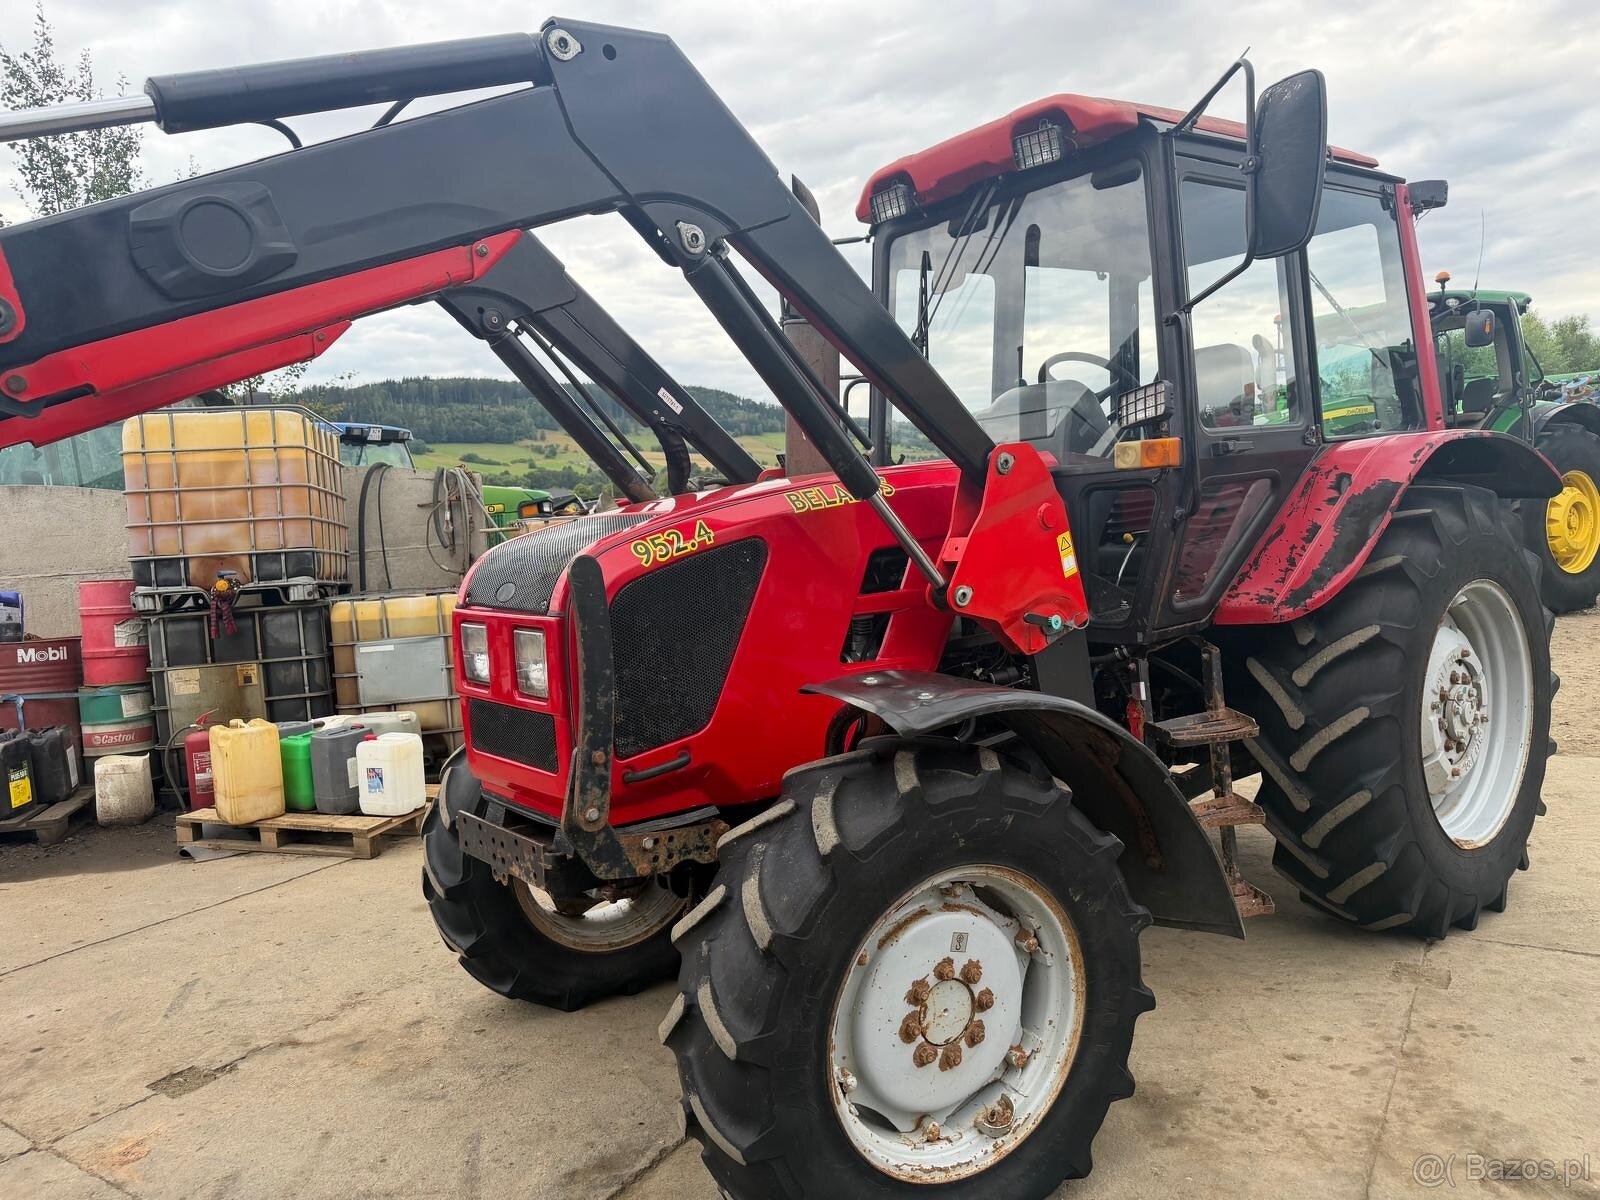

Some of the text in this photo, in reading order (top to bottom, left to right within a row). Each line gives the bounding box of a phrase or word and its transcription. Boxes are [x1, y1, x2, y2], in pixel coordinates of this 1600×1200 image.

[784, 477, 895, 513] BELAS
[630, 519, 715, 568] 952.4
[17, 646, 67, 663] Mobil
[101, 731, 136, 744] Castrol
